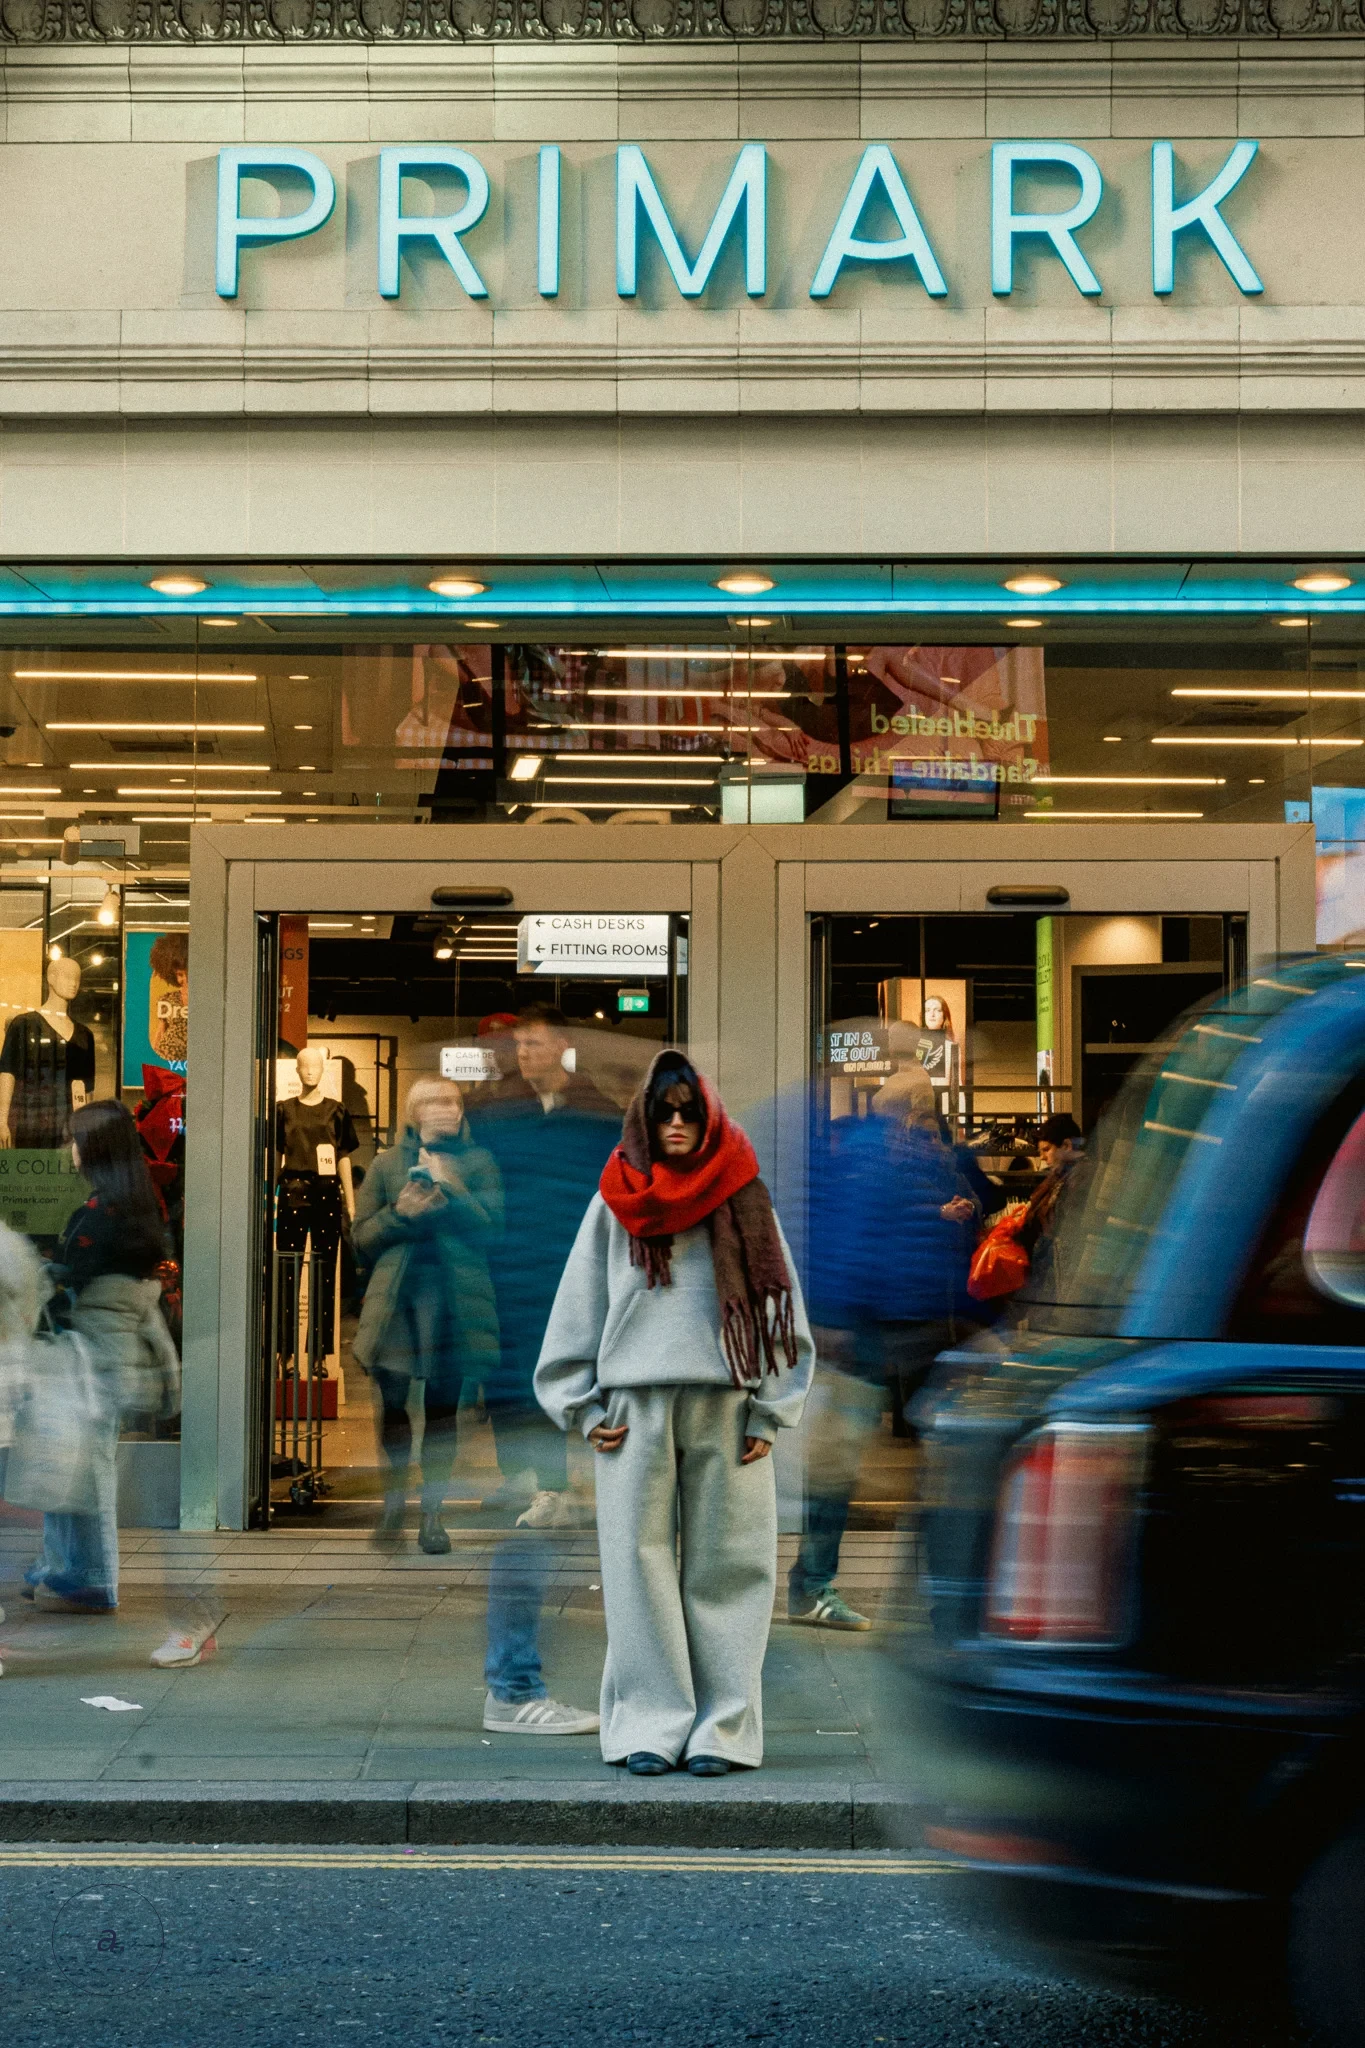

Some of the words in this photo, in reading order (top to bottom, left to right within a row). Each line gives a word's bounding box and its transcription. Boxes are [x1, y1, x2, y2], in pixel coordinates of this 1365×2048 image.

[215, 141, 1265, 300] PRIMARK
[551, 918, 592, 930] CASH
[597, 918, 645, 931] DESKS
[551, 943, 607, 957] FITTING
[612, 944, 669, 957] ROOMS
[157, 1000, 188, 1018] Dre
[843, 1032, 860, 1046] IN
[861, 1031, 874, 1046] &
[455, 1051, 480, 1060] CASH
[849, 1046, 880, 1061] OUT
[455, 1066, 489, 1074] FITTING
[0, 1159, 10, 1175] &
[2, 1195, 59, 1205] Primark.com
